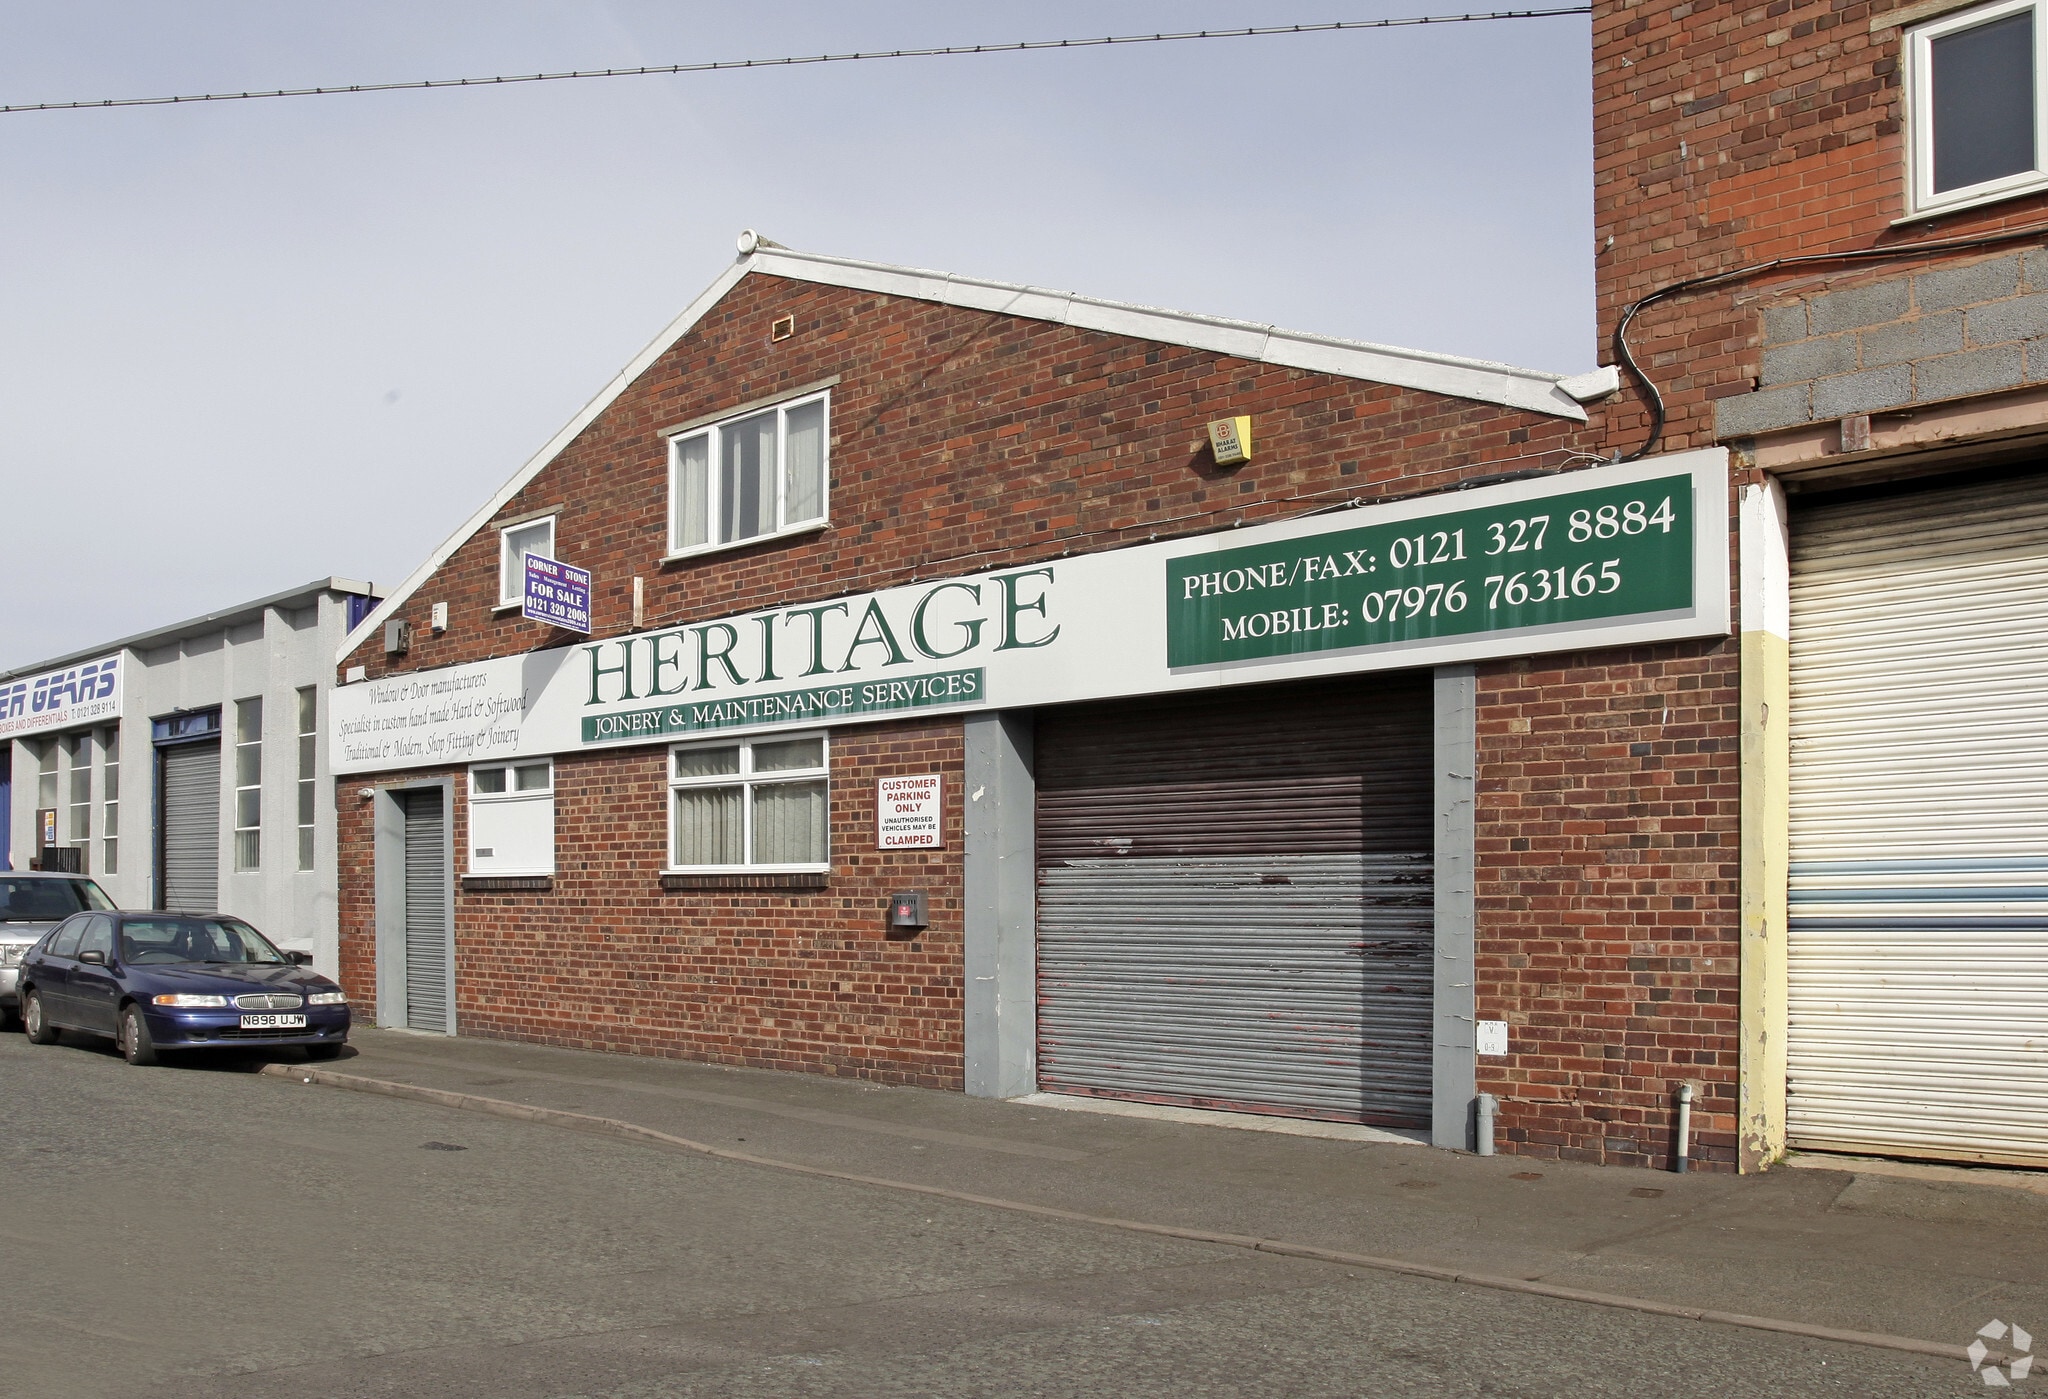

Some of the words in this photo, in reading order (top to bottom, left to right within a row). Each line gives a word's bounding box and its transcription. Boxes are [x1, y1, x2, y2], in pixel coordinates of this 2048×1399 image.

[1218, 444, 1239, 454] ALARMS
[1182, 549, 1376, 600] PHONE/FAX:
[1389, 528, 1467, 569] 0121
[1484, 515, 1550, 556] 327
[1568, 496, 1676, 543] 8884
[528, 558, 558, 576] CORNER
[565, 569, 588, 585] STONE
[531, 581, 554, 599] FOR
[557, 589, 583, 607] SALE
[1221, 603, 1349, 642] MOBILE:
[1362, 580, 1467, 623] 07976
[1484, 557, 1621, 610] 763165
[526, 595, 547, 612] 0121
[550, 602, 565, 617] 320
[567, 607, 587, 622] 2008
[582, 567, 1061, 707] HERITAGE
[32, 659, 118, 713] GEARS
[369, 683, 400, 705] Window
[400, 684, 409, 701] &
[410, 682, 430, 700] Door
[431, 671, 487, 700] manufacturers
[15, 719, 26, 730] AND
[27, 710, 68, 729] DIFFERENTIALS
[101, 700, 116, 714] 9114
[338, 713, 371, 742] Specialist
[373, 715, 380, 731] in
[381, 715, 407, 730] custom
[408, 704, 429, 727] hand
[429, 701, 450, 724] made
[451, 696, 474, 720] Hard
[474, 699, 484, 717] &
[485, 688, 528, 723] Softwood
[594, 710, 663, 739] JOINERY
[669, 708, 686, 726] &
[692, 687, 854, 724] MAINTENANCE
[862, 673, 976, 705] SERVICES
[345, 739, 382, 761] Traditional
[382, 741, 391, 758] &
[394, 736, 424, 757] Modern,
[426, 732, 445, 759] Shop
[446, 730, 475, 756] Fitting
[476, 729, 486, 747] &
[486, 725, 520, 751] Joinery
[882, 779, 937, 790] CUSTOMER
[887, 791, 931, 802] PARKING
[884, 816, 933, 824] UNAUTHORISED
[895, 803, 922, 813] ONLY
[885, 835, 933, 845] CLAMPED
[242, 1015, 276, 1025] N898
